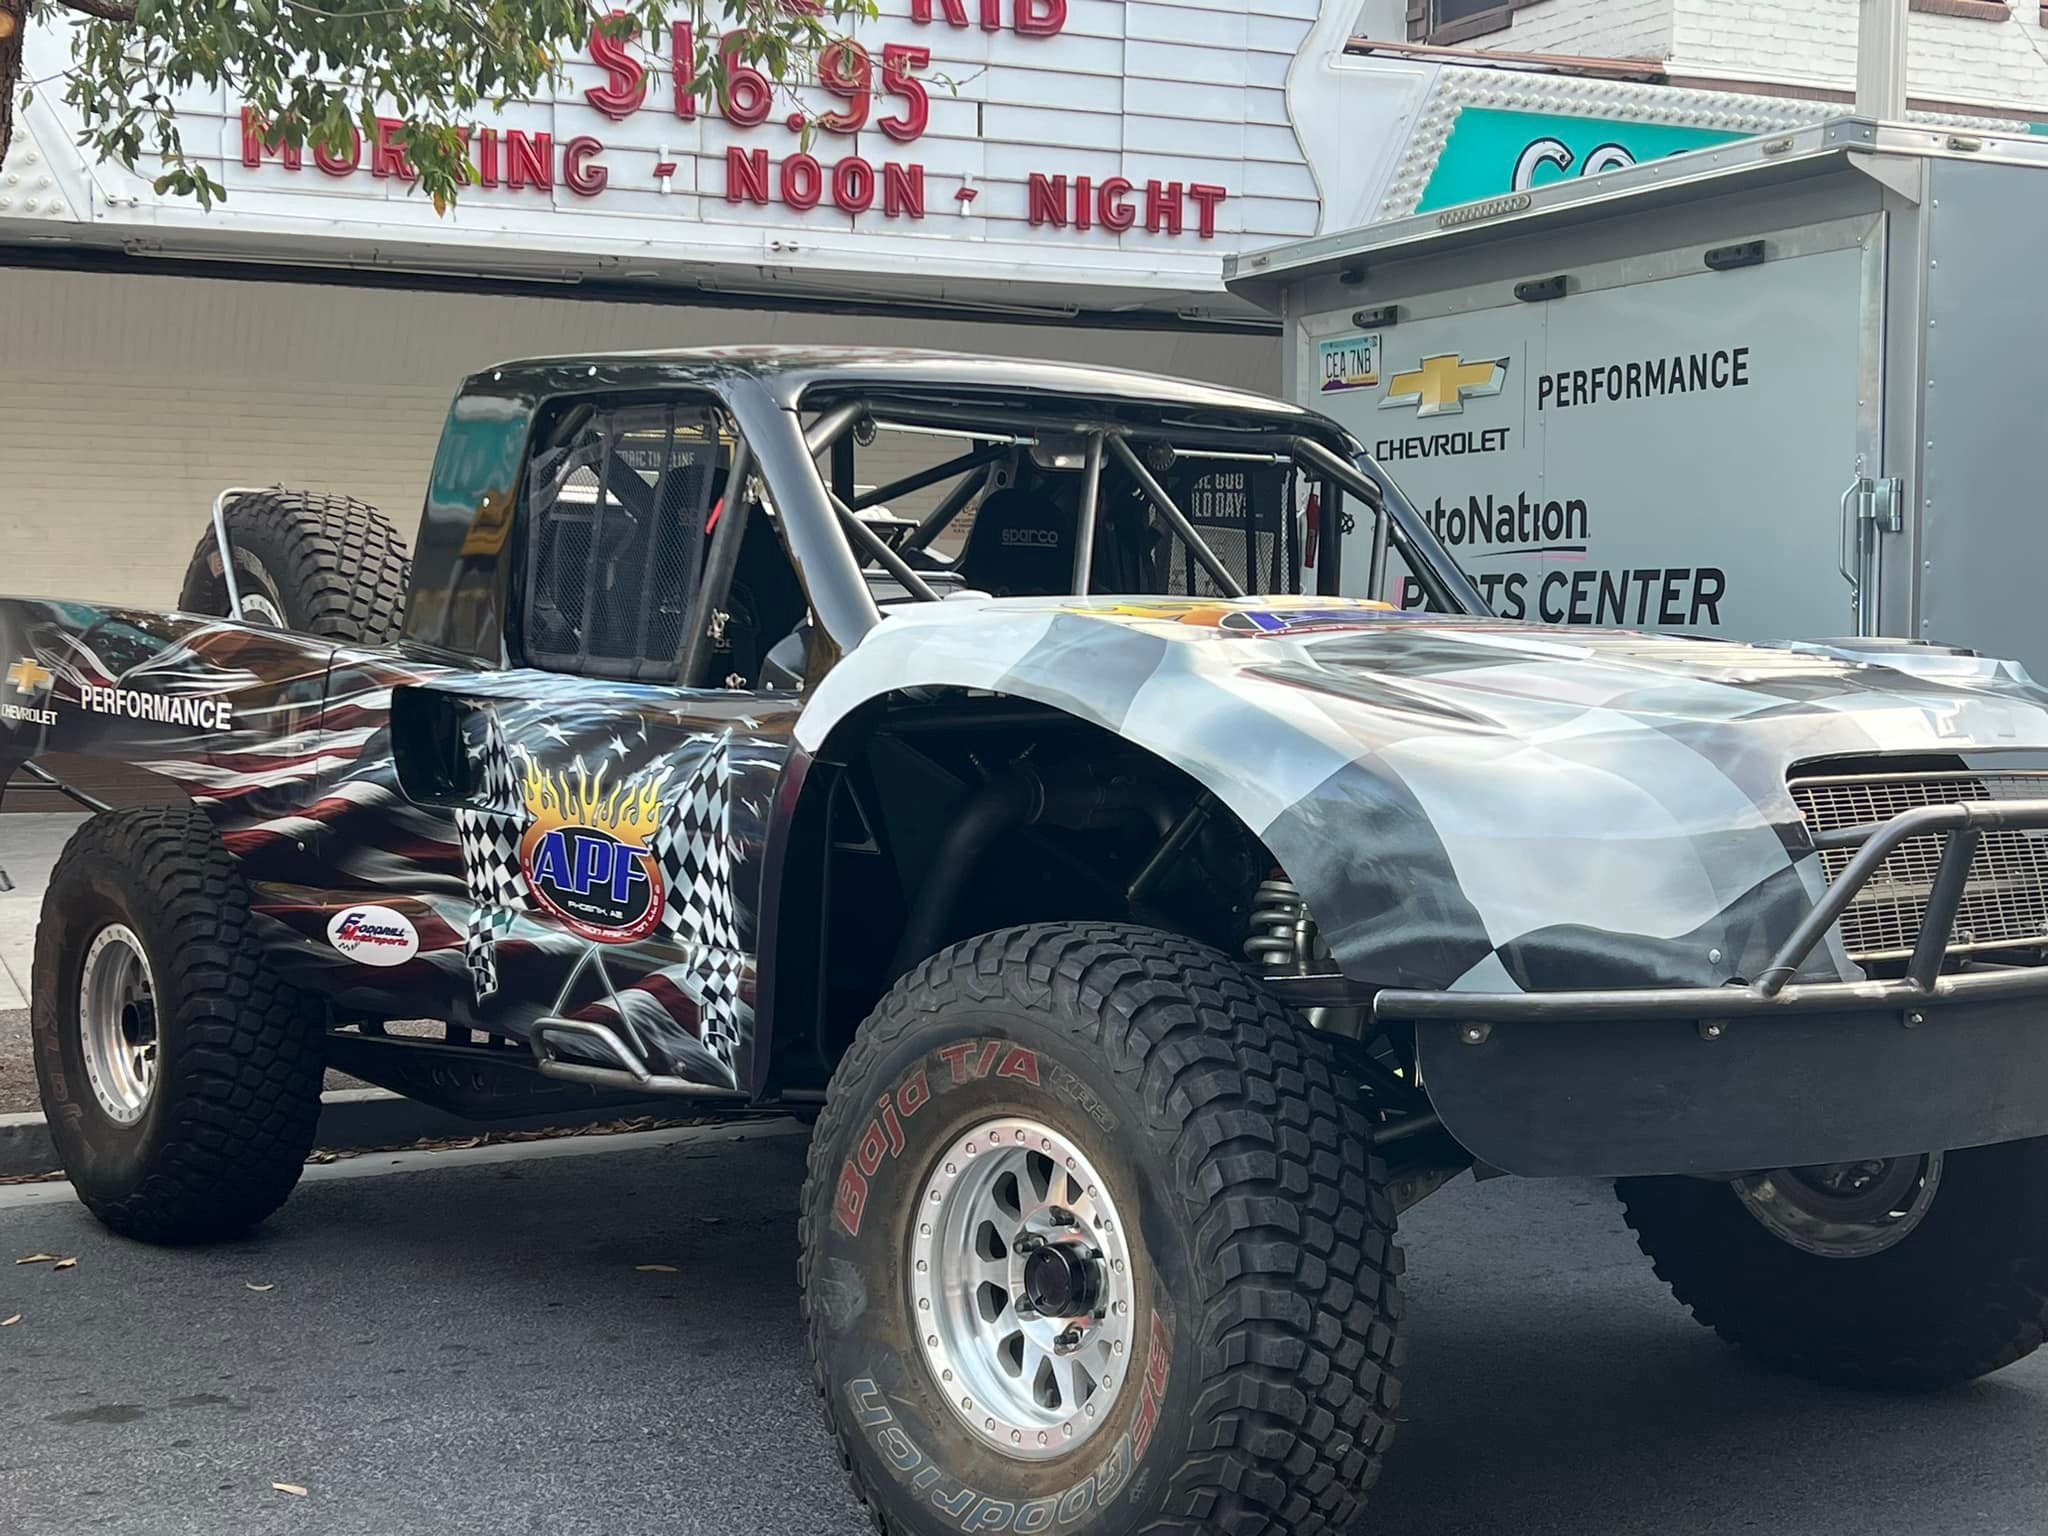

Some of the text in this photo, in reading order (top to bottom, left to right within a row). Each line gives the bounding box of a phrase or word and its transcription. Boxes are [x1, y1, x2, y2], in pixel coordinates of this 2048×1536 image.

[584, 9, 931, 142] $16.95
[241, 104, 609, 197] MORING
[727, 146, 925, 219] NOON
[1029, 172, 1227, 239] NIGHT
[1325, 347, 1372, 379] CEA 7NB
[1538, 346, 1750, 411] PERFORMANCE
[1376, 426, 1511, 462] CHEVROLET
[1001, 528, 1058, 545] sparco
[1425, 490, 1587, 545] toNation
[1401, 567, 1726, 625] PTS CENTER
[1, 703, 58, 726] CHEVROLET
[80, 684, 233, 730] PERFORMANCE
[533, 830, 651, 904] APF
[834, 1070, 931, 1237] Baja
[939, 1040, 1041, 1087] T/A
[849, 1309, 1169, 1534] BFGoodrich
